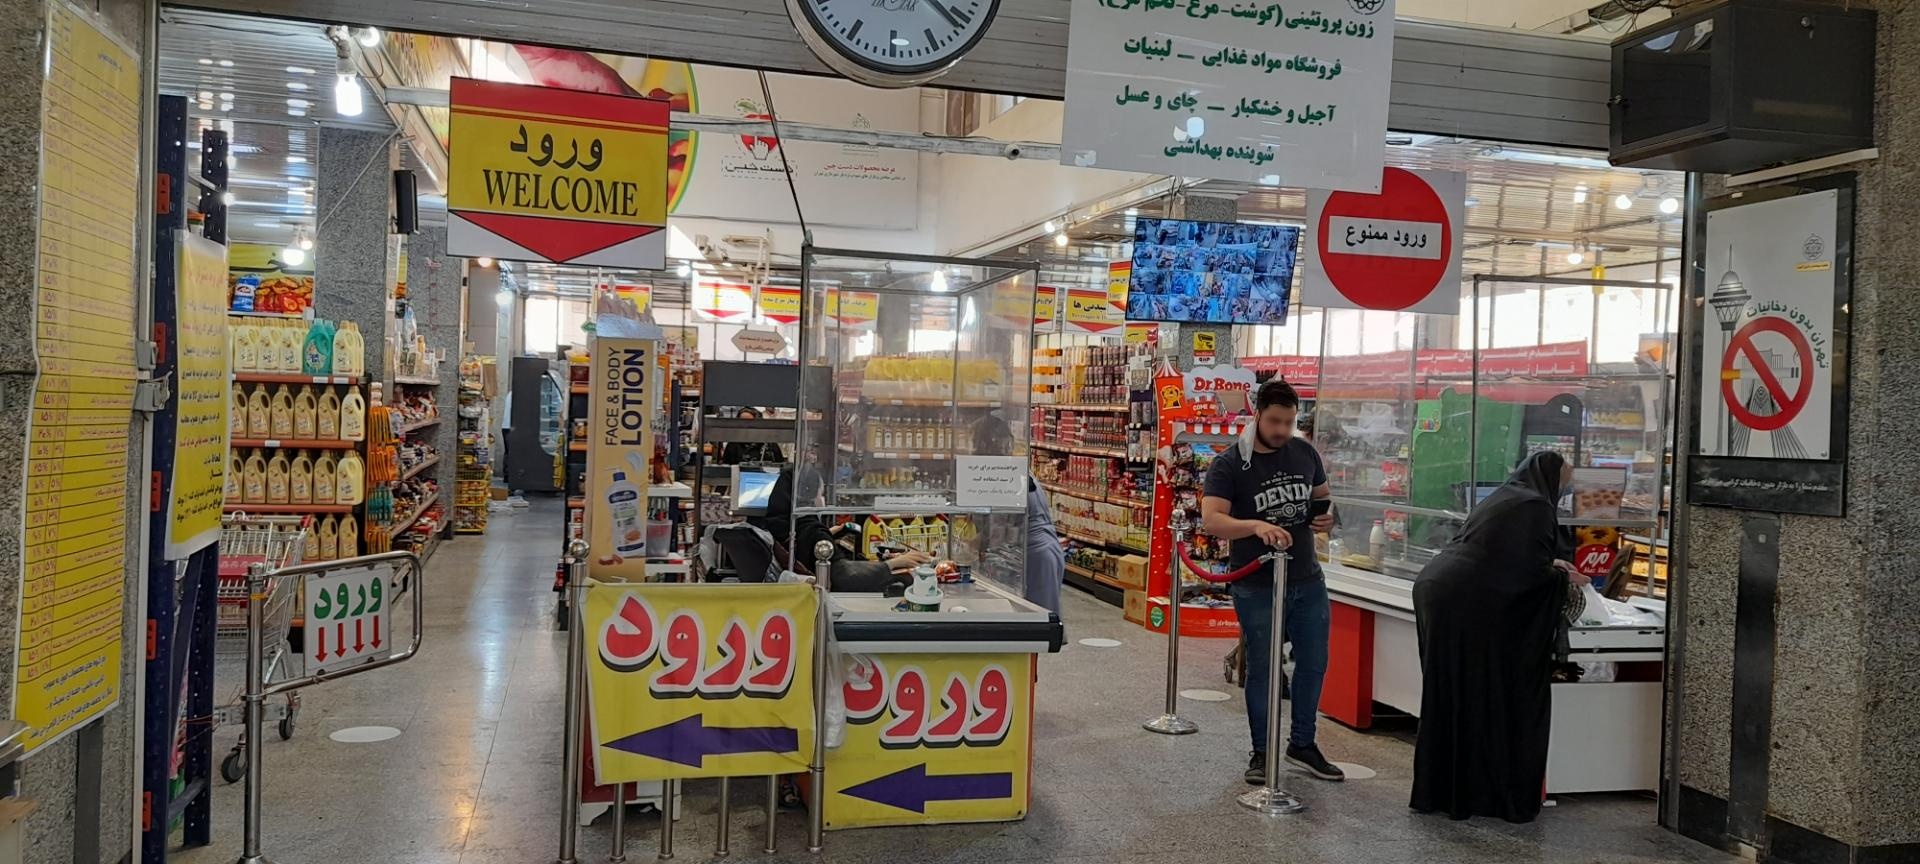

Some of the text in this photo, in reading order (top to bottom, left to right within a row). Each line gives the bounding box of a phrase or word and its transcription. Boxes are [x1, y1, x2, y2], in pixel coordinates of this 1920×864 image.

[1346, 18, 1374, 38] زون
[1124, 37, 1342, 80] فروشگاه مواد غذایی لبنیات
[1116, 85, 1336, 126] آجیل و خشکبار چای و عسل
[510, 124, 603, 172] ورود
[1226, 144, 1274, 165] شوینده
[482, 168, 638, 217] WELCOME
[1345, 224, 1427, 248] ورود ممنوع
[1747, 300, 1829, 368] تهران بدون دخانیات
[605, 346, 621, 446] FACE & BODY
[620, 348, 646, 446] LOTION
[314, 577, 382, 620] ورود
[599, 594, 797, 699] ورود
[843, 654, 1014, 749] ورود
